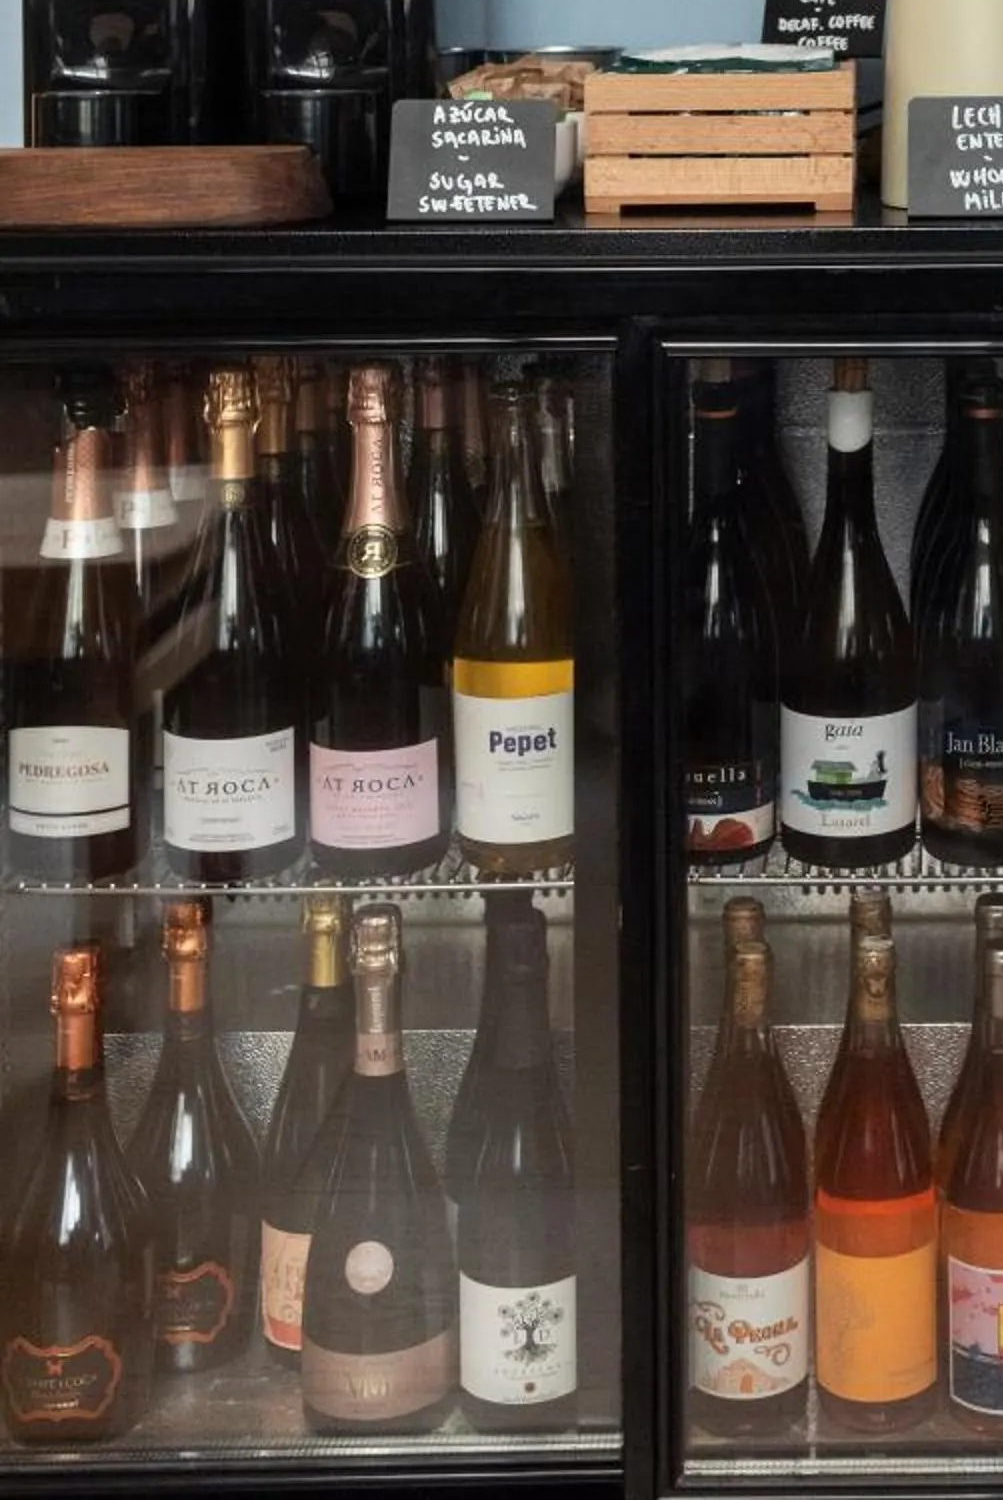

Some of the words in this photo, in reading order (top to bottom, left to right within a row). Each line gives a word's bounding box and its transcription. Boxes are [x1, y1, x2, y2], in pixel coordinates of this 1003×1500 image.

[827, 14, 876, 30] COFFEE
[433, 101, 515, 125] AZÚCAR
[428, 171, 505, 195] SUGAR
[489, 727, 557, 757] Pepet
[945, 731, 974, 754] Jan
